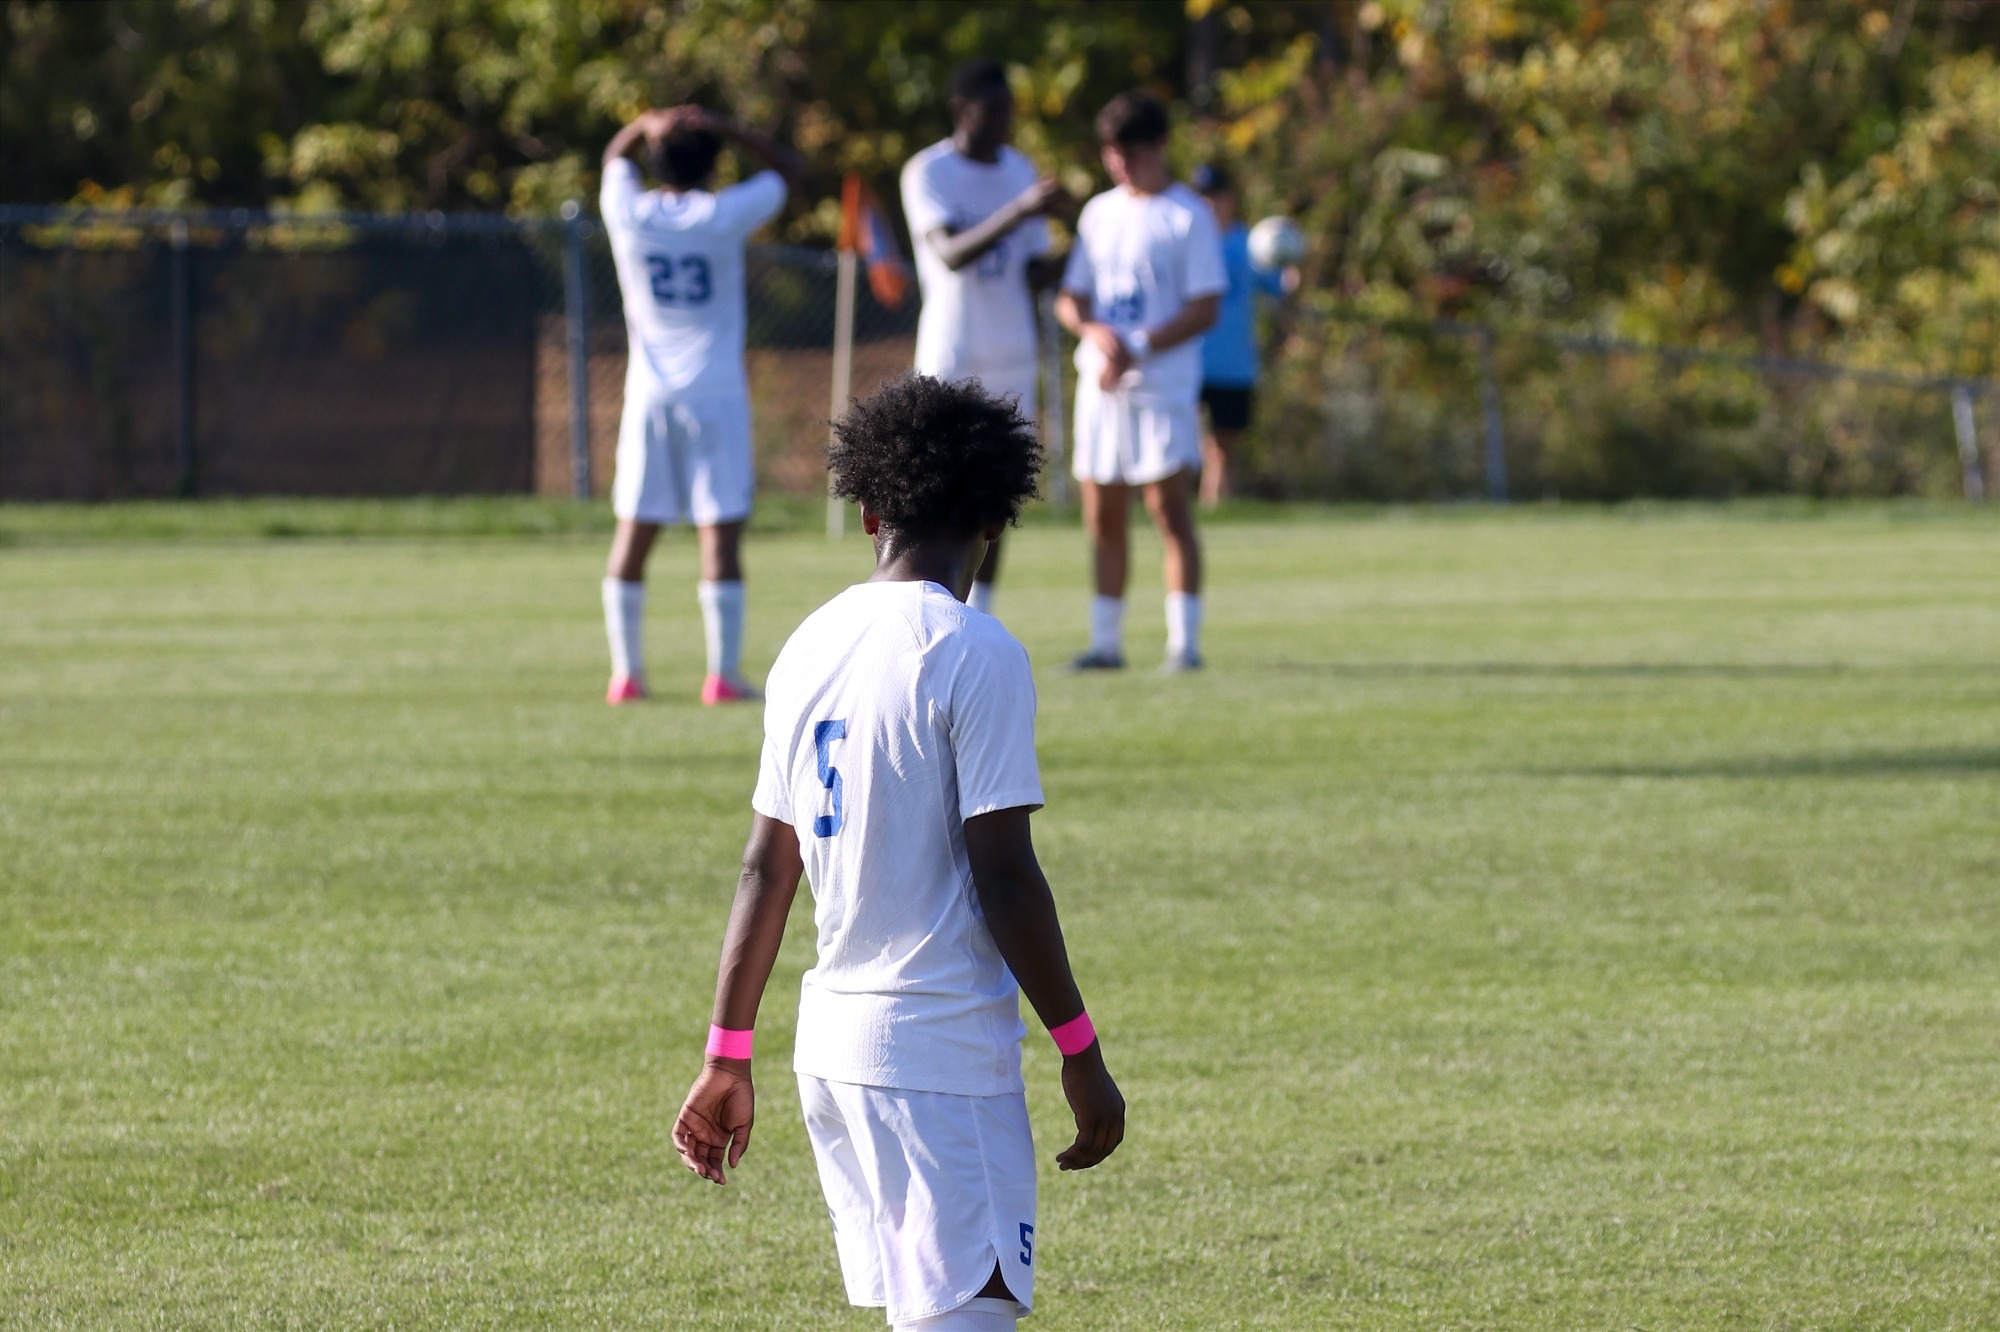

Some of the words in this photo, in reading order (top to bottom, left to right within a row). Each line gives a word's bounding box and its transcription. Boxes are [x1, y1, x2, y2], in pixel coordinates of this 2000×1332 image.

[645, 253, 711, 303] 23
[813, 718, 846, 838] 5
[1019, 1222, 1034, 1267] 5
